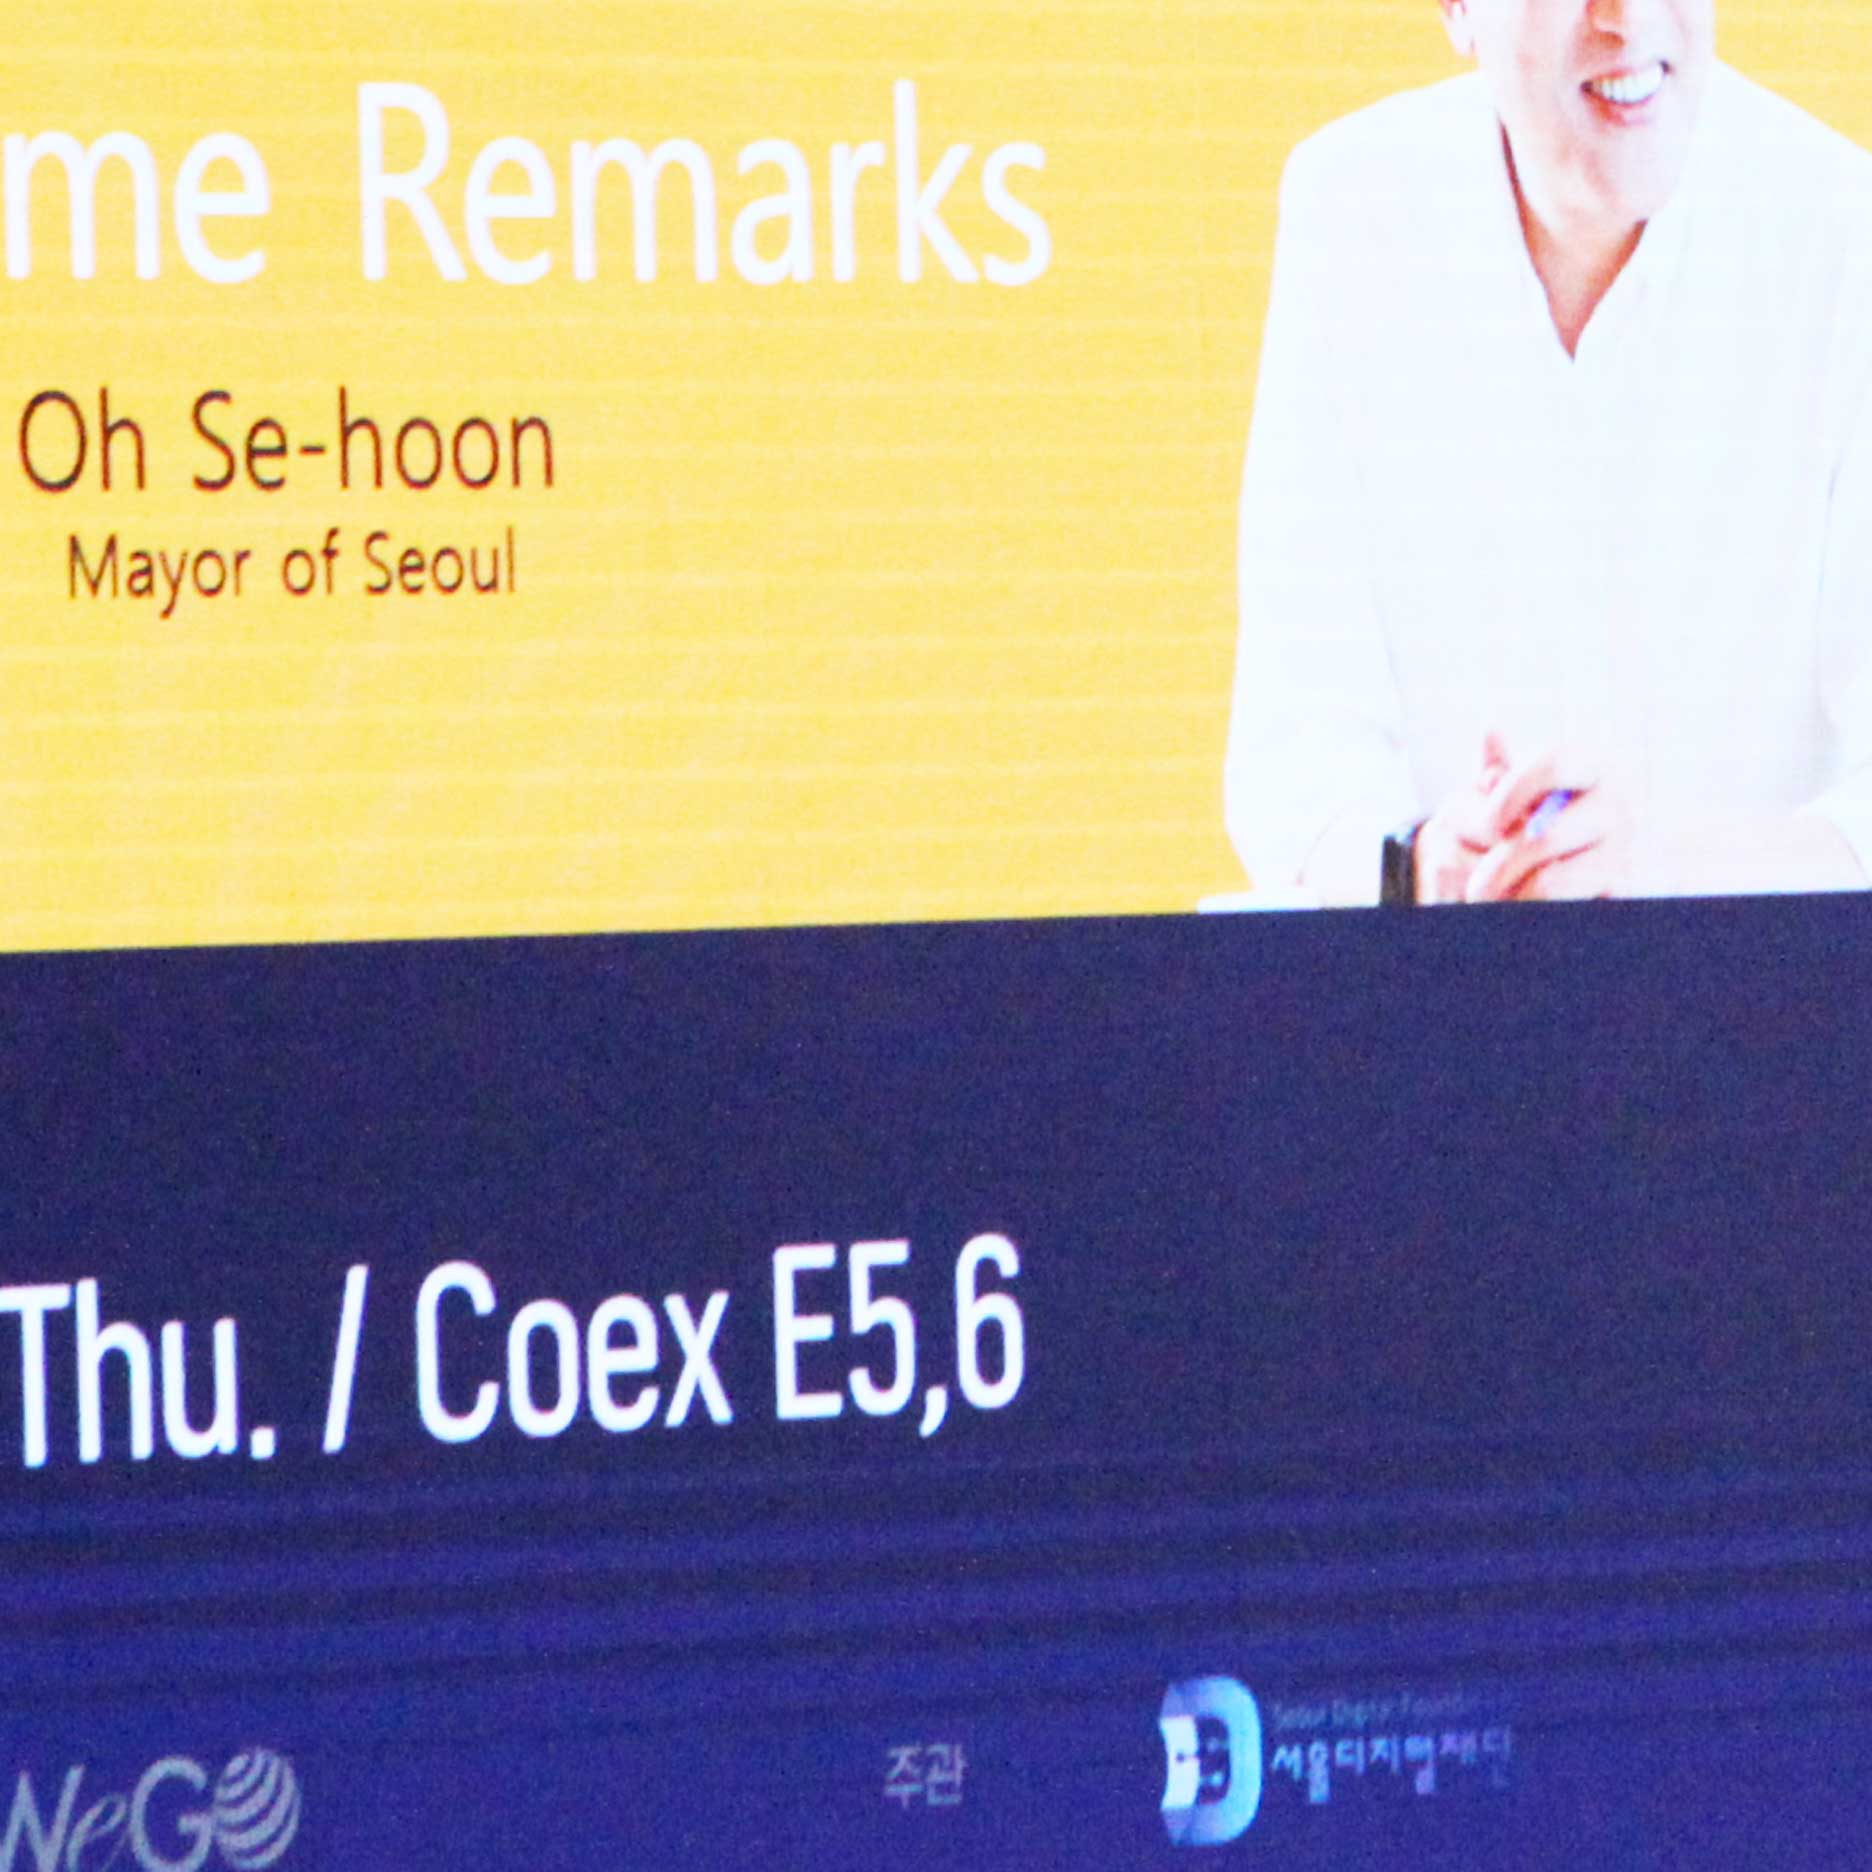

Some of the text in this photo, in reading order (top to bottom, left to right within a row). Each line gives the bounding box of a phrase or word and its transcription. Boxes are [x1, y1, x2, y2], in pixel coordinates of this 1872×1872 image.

[4, 79, 1053, 286] me Remarks
[18, 385, 556, 494] Oh Se-hoon
[68, 525, 516, 619] Mayor of Seoul
[0, 1232, 1026, 1469] Thu. / Coex E5,6
[884, 1742, 966, 1809] 주관
